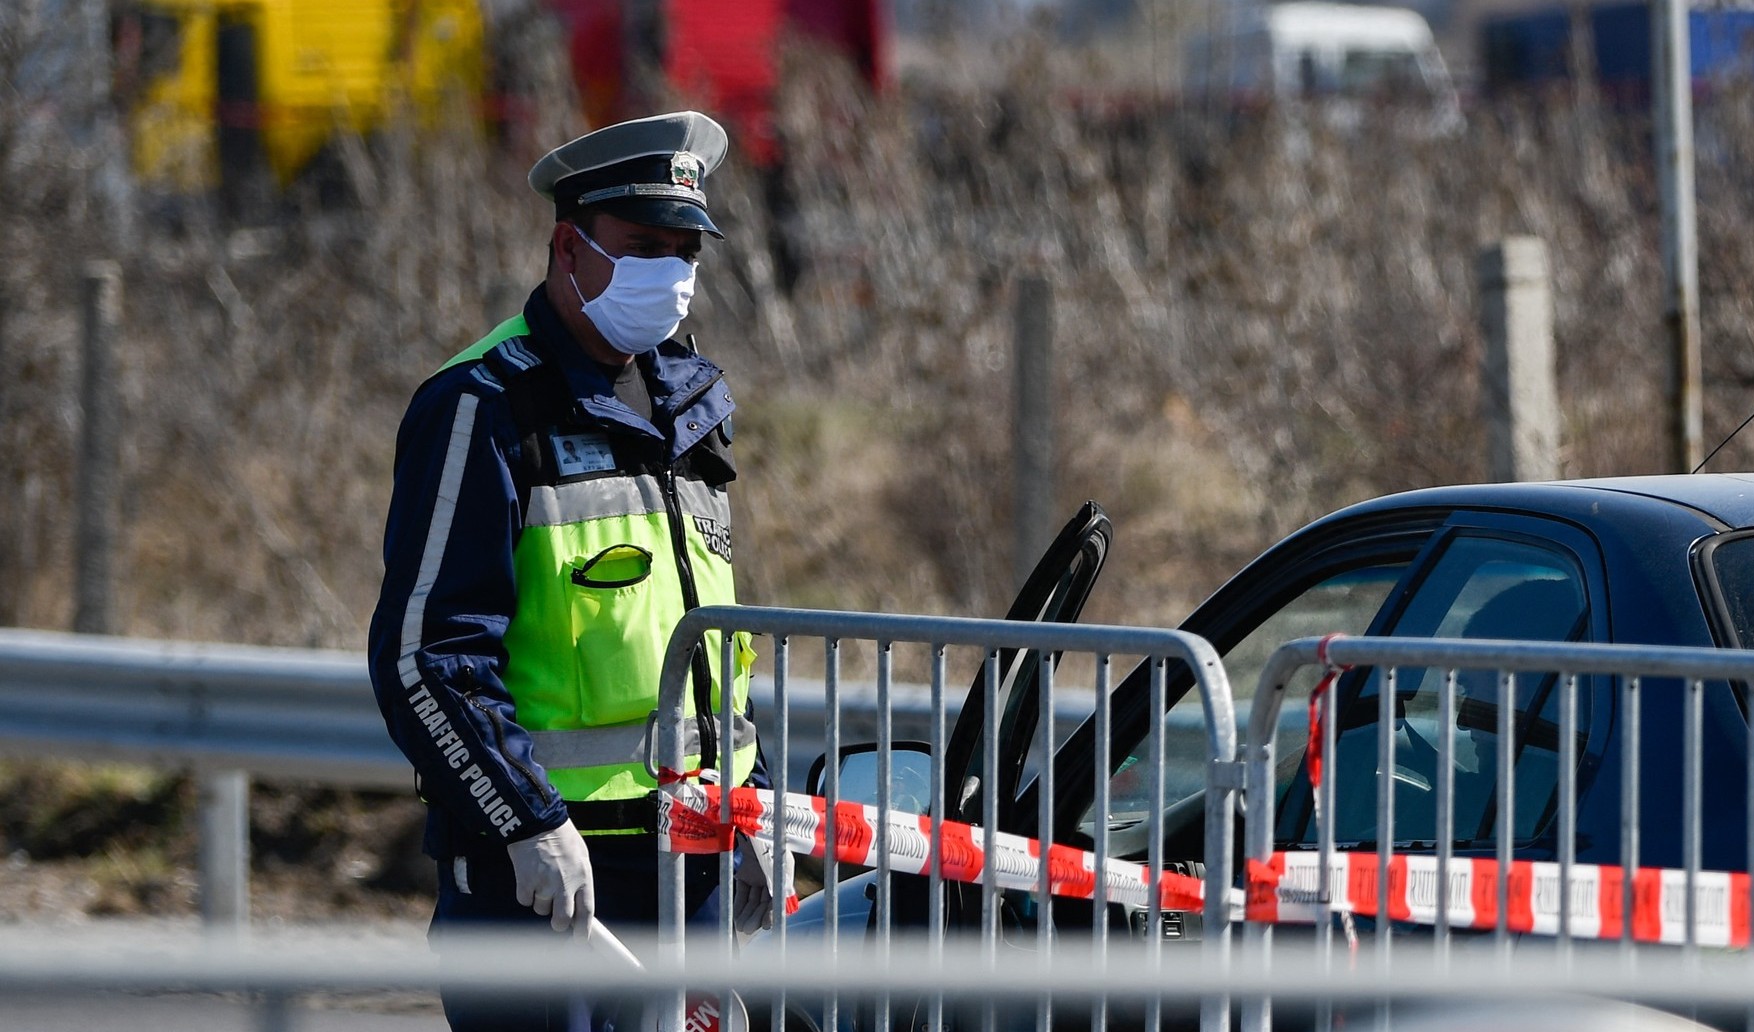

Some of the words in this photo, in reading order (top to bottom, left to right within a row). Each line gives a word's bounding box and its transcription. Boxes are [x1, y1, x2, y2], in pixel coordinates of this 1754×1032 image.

[694, 517, 731, 546] TRAIC
[408, 684, 470, 769] TRAFFIC
[459, 763, 522, 838] POLICE
